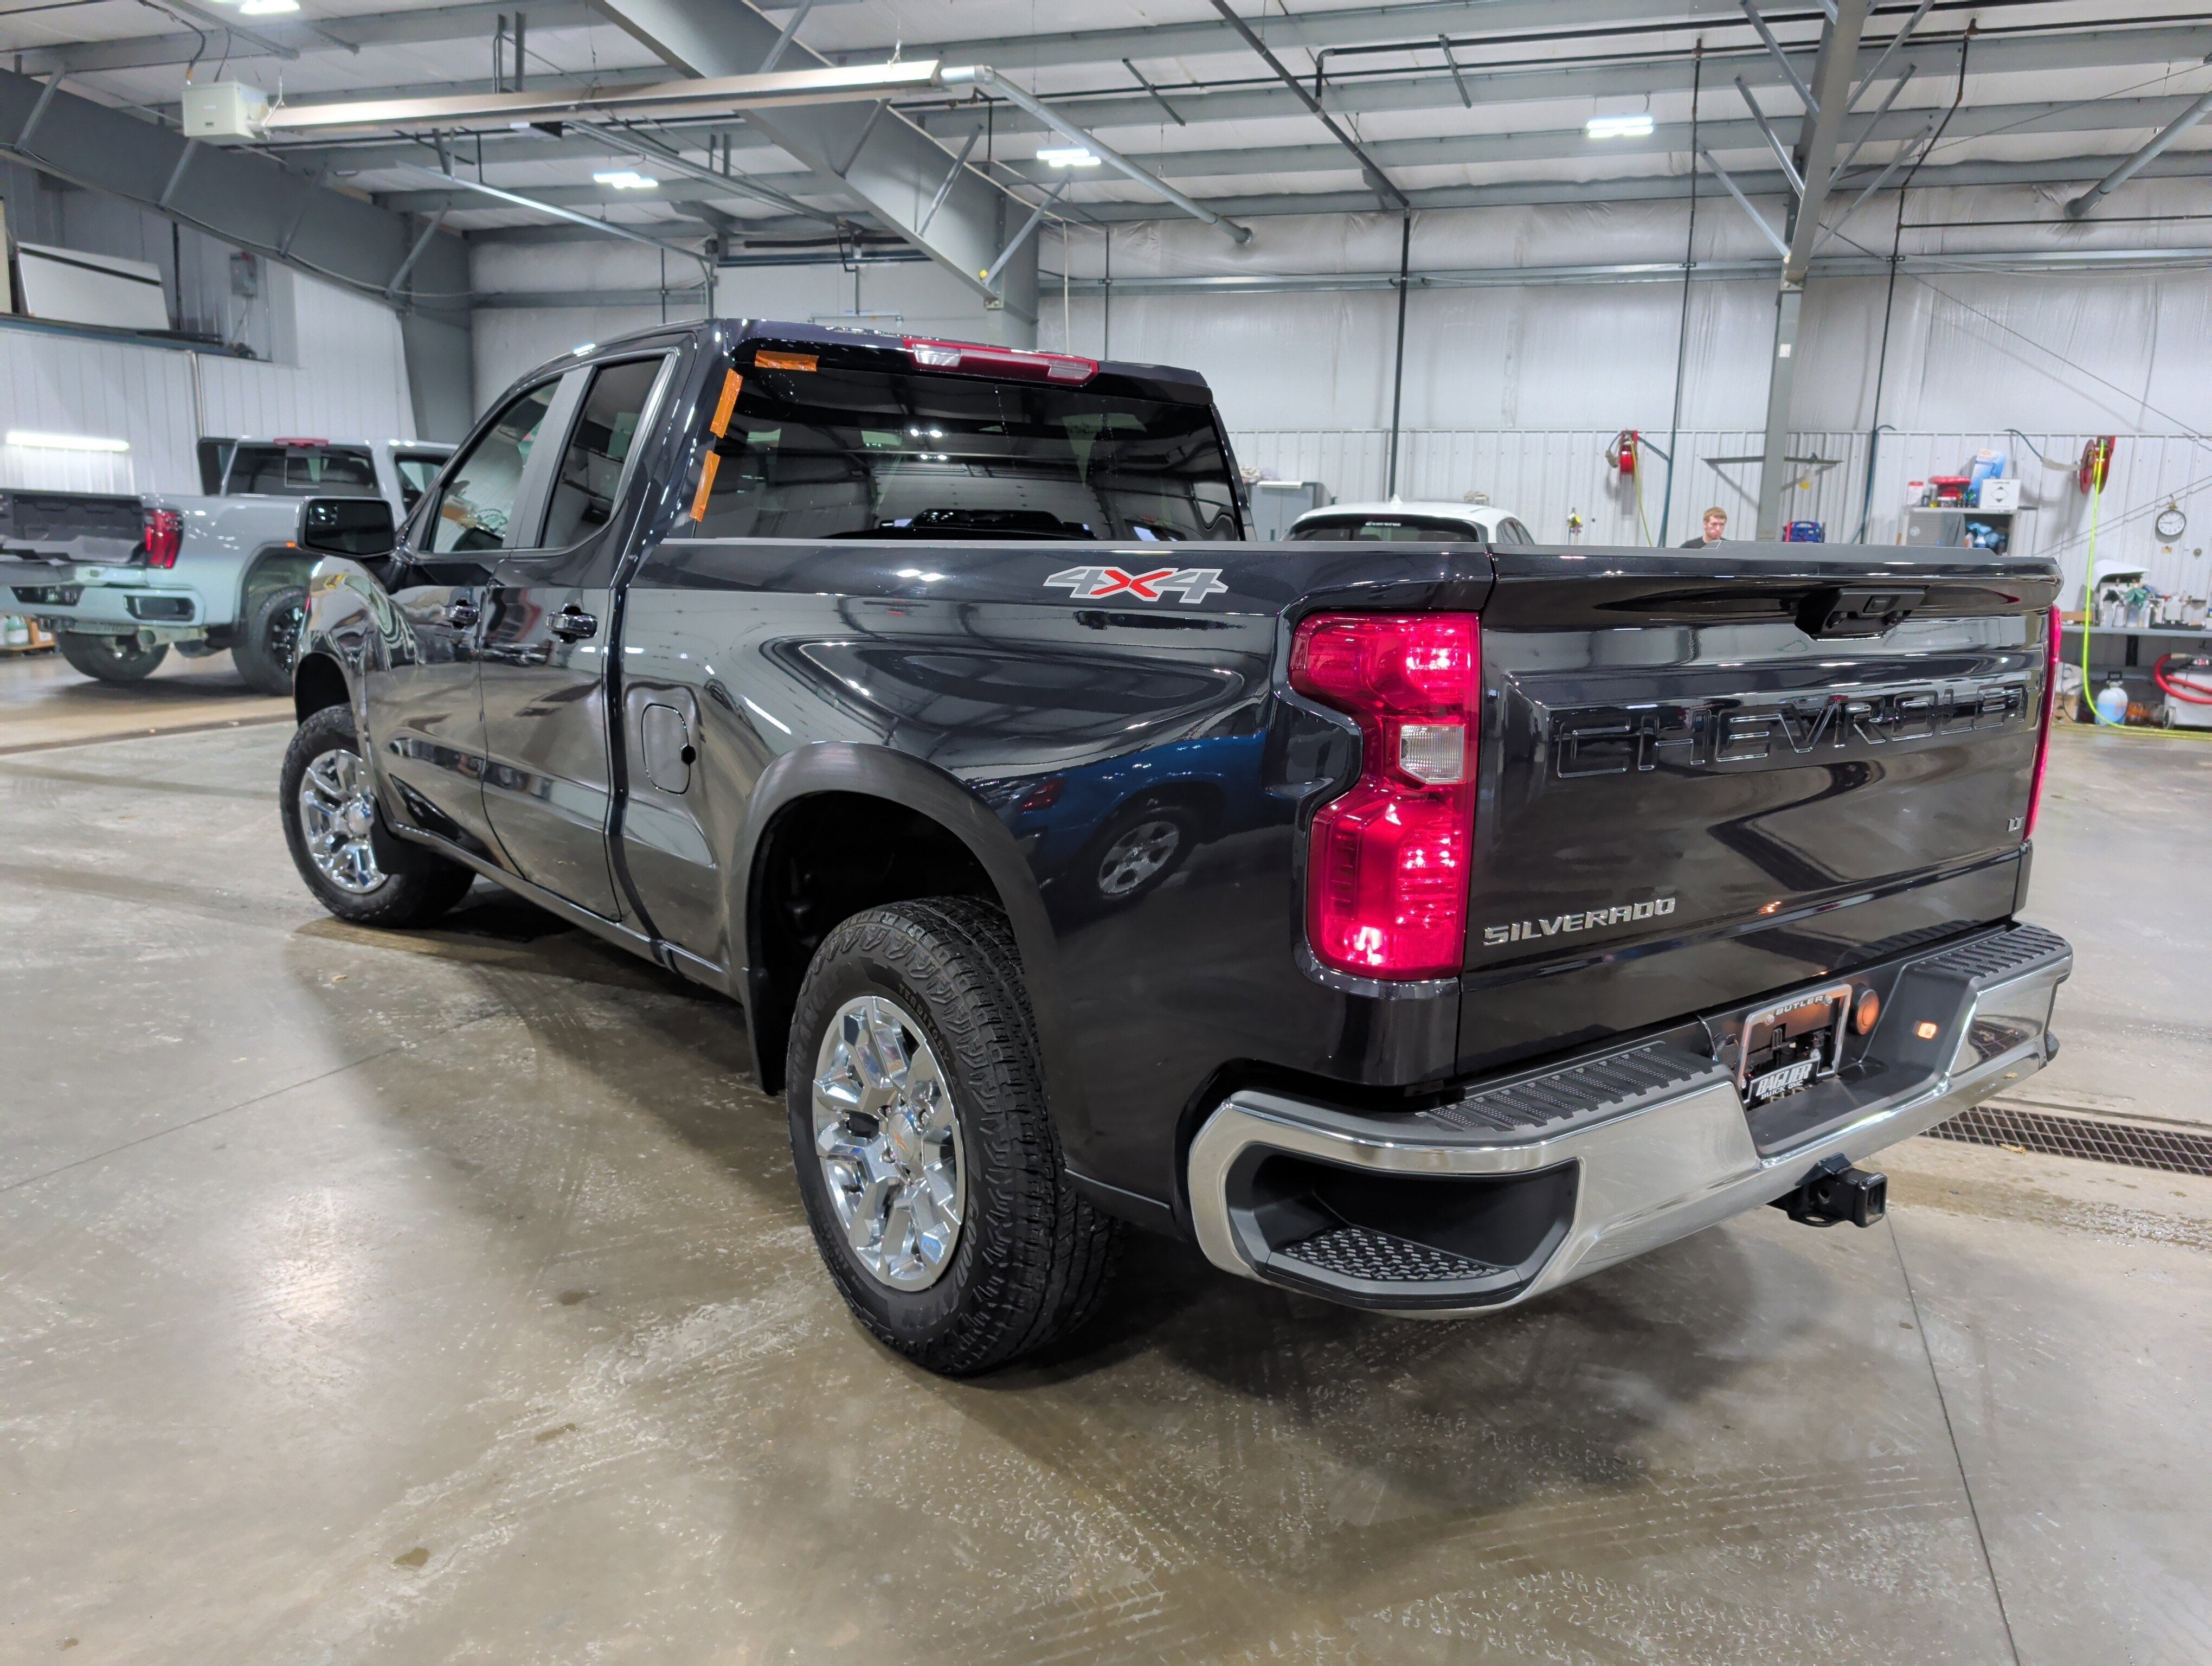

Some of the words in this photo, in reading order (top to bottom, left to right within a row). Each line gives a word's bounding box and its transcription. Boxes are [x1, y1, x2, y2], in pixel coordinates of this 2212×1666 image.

[1557, 684, 2026, 779] CHEVROLET
[2008, 816, 2025, 832] LT
[1482, 897, 1675, 946] SILVERADO
[897, 982, 950, 1063] TERRITORY
[1776, 996, 1823, 1015] BUTLER
[1756, 1063, 1812, 1097] BAGLIER
[1760, 1086, 1786, 1100] BUICK
[1787, 1080, 1804, 1089] GMC
